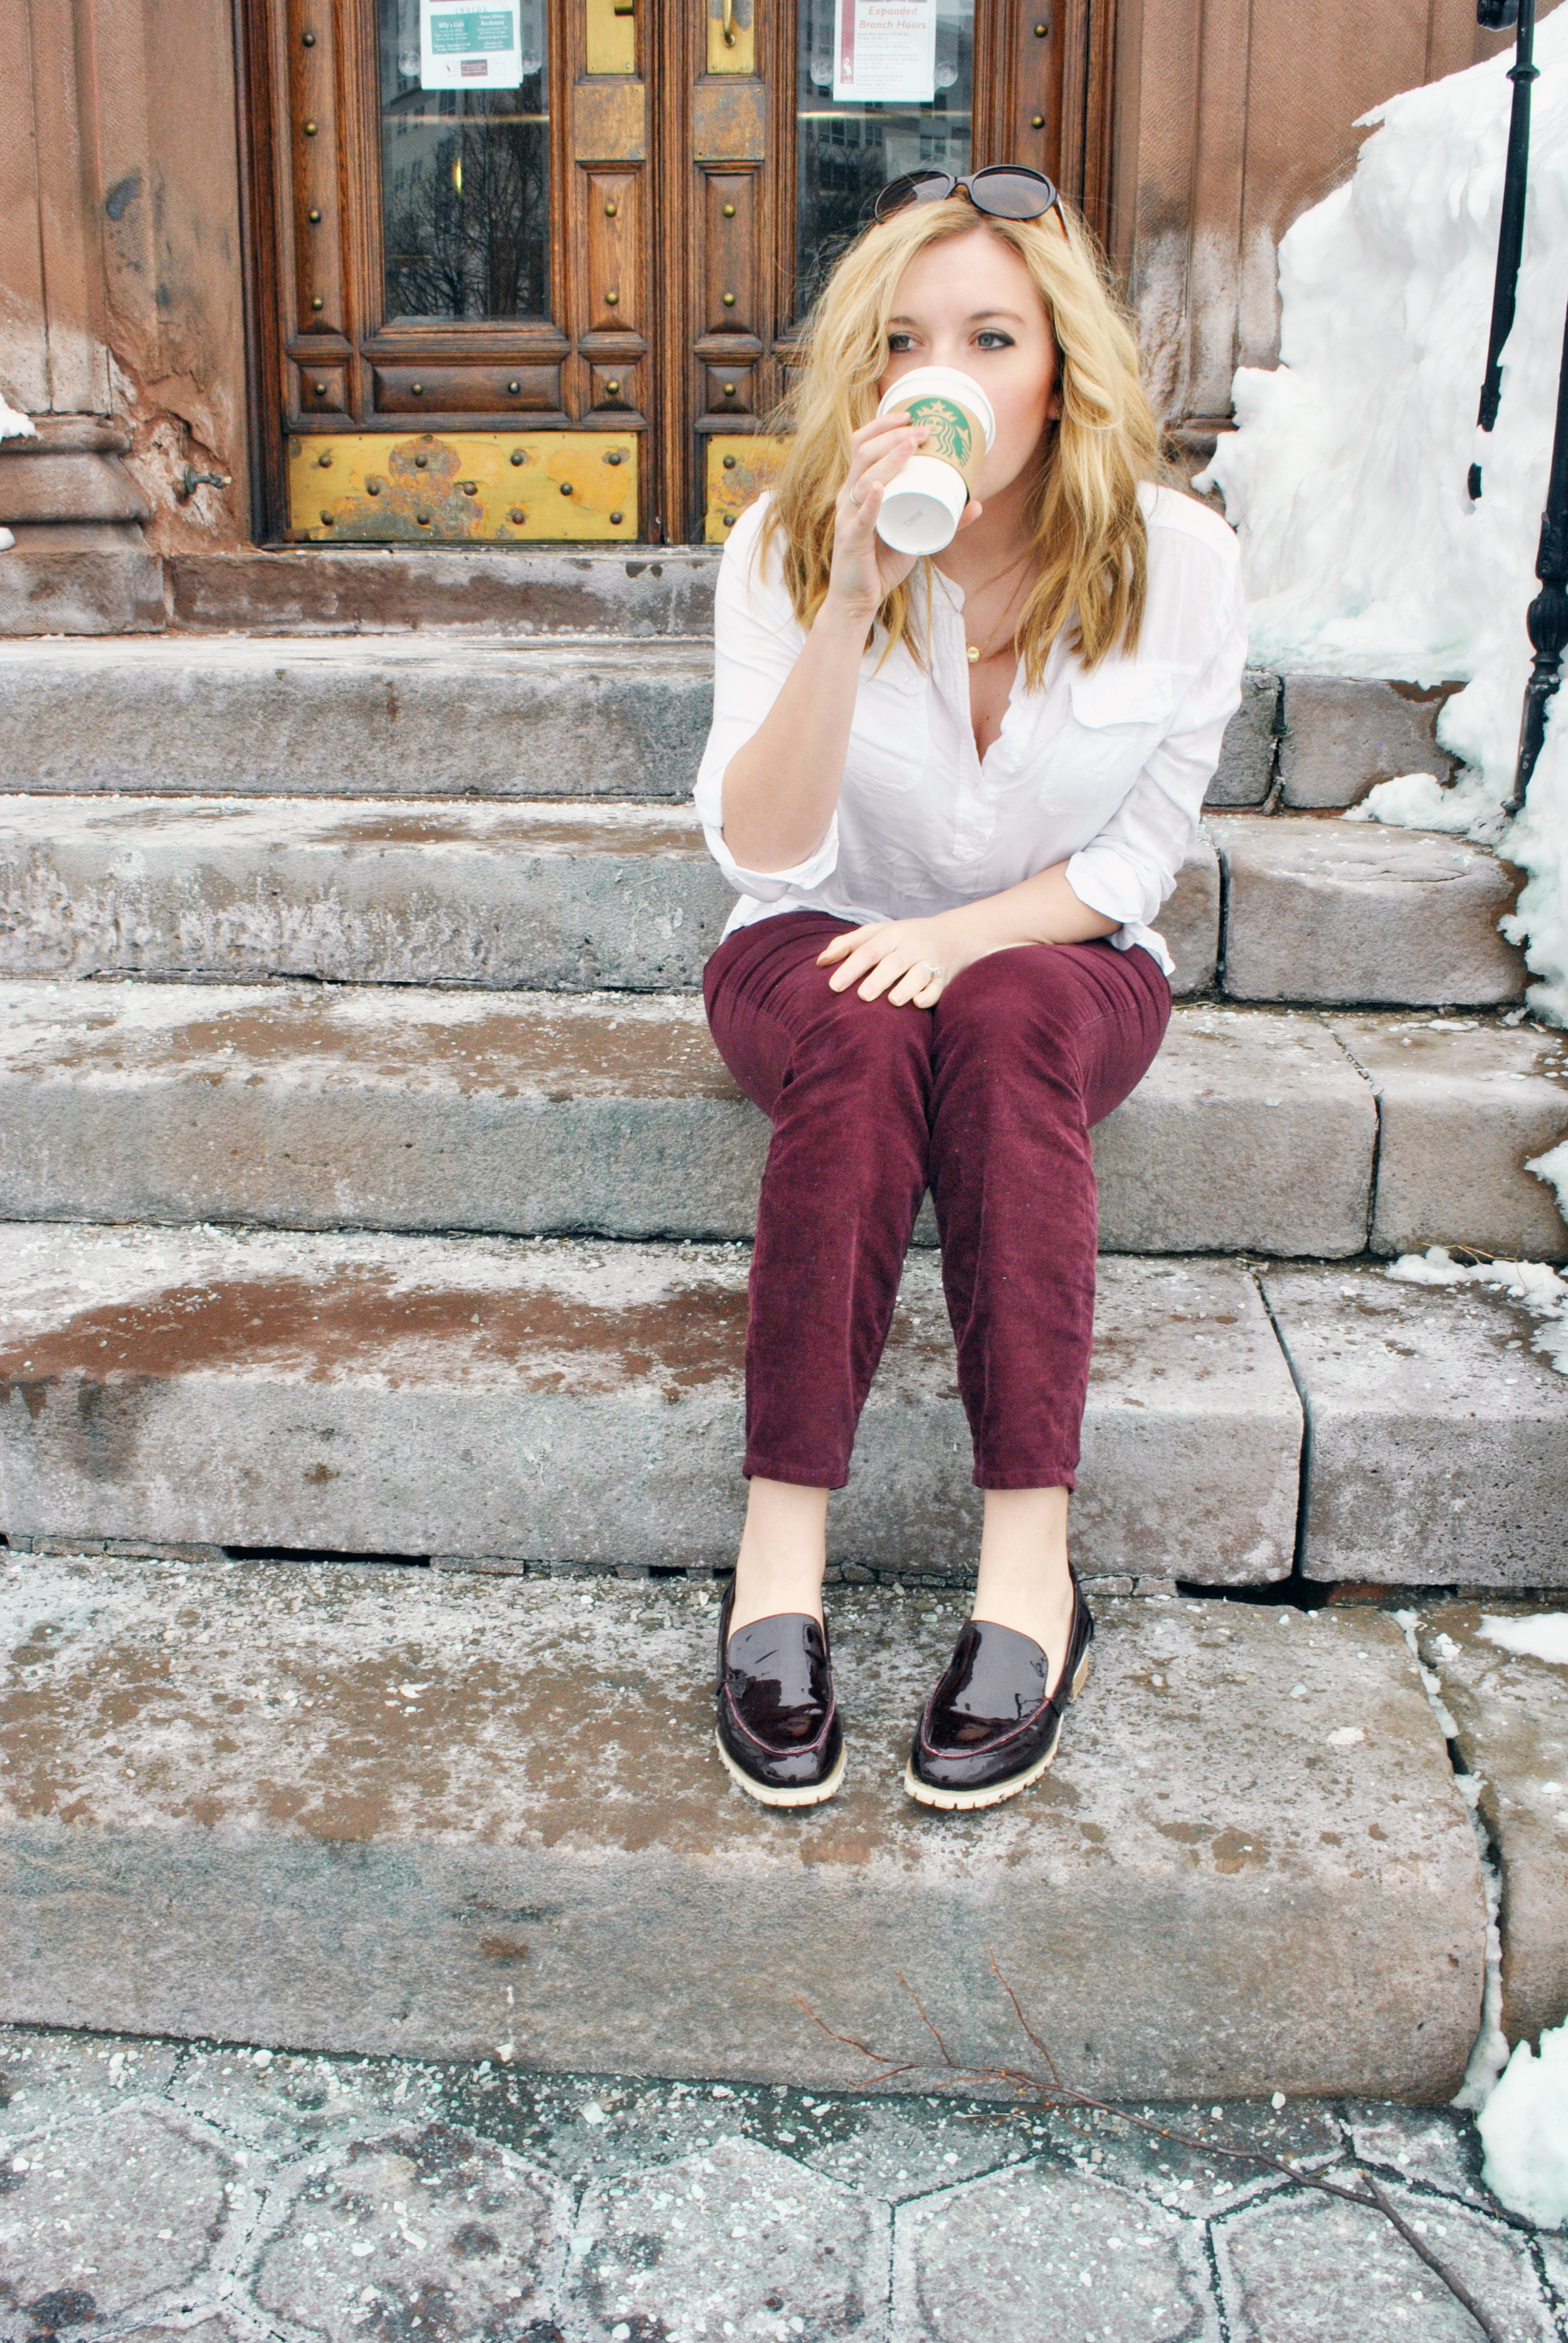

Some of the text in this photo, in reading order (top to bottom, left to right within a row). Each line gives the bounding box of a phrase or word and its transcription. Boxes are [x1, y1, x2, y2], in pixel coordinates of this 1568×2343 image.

[869, 6, 918, 17] Expanded
[859, 20, 926, 29] Branch Hours
